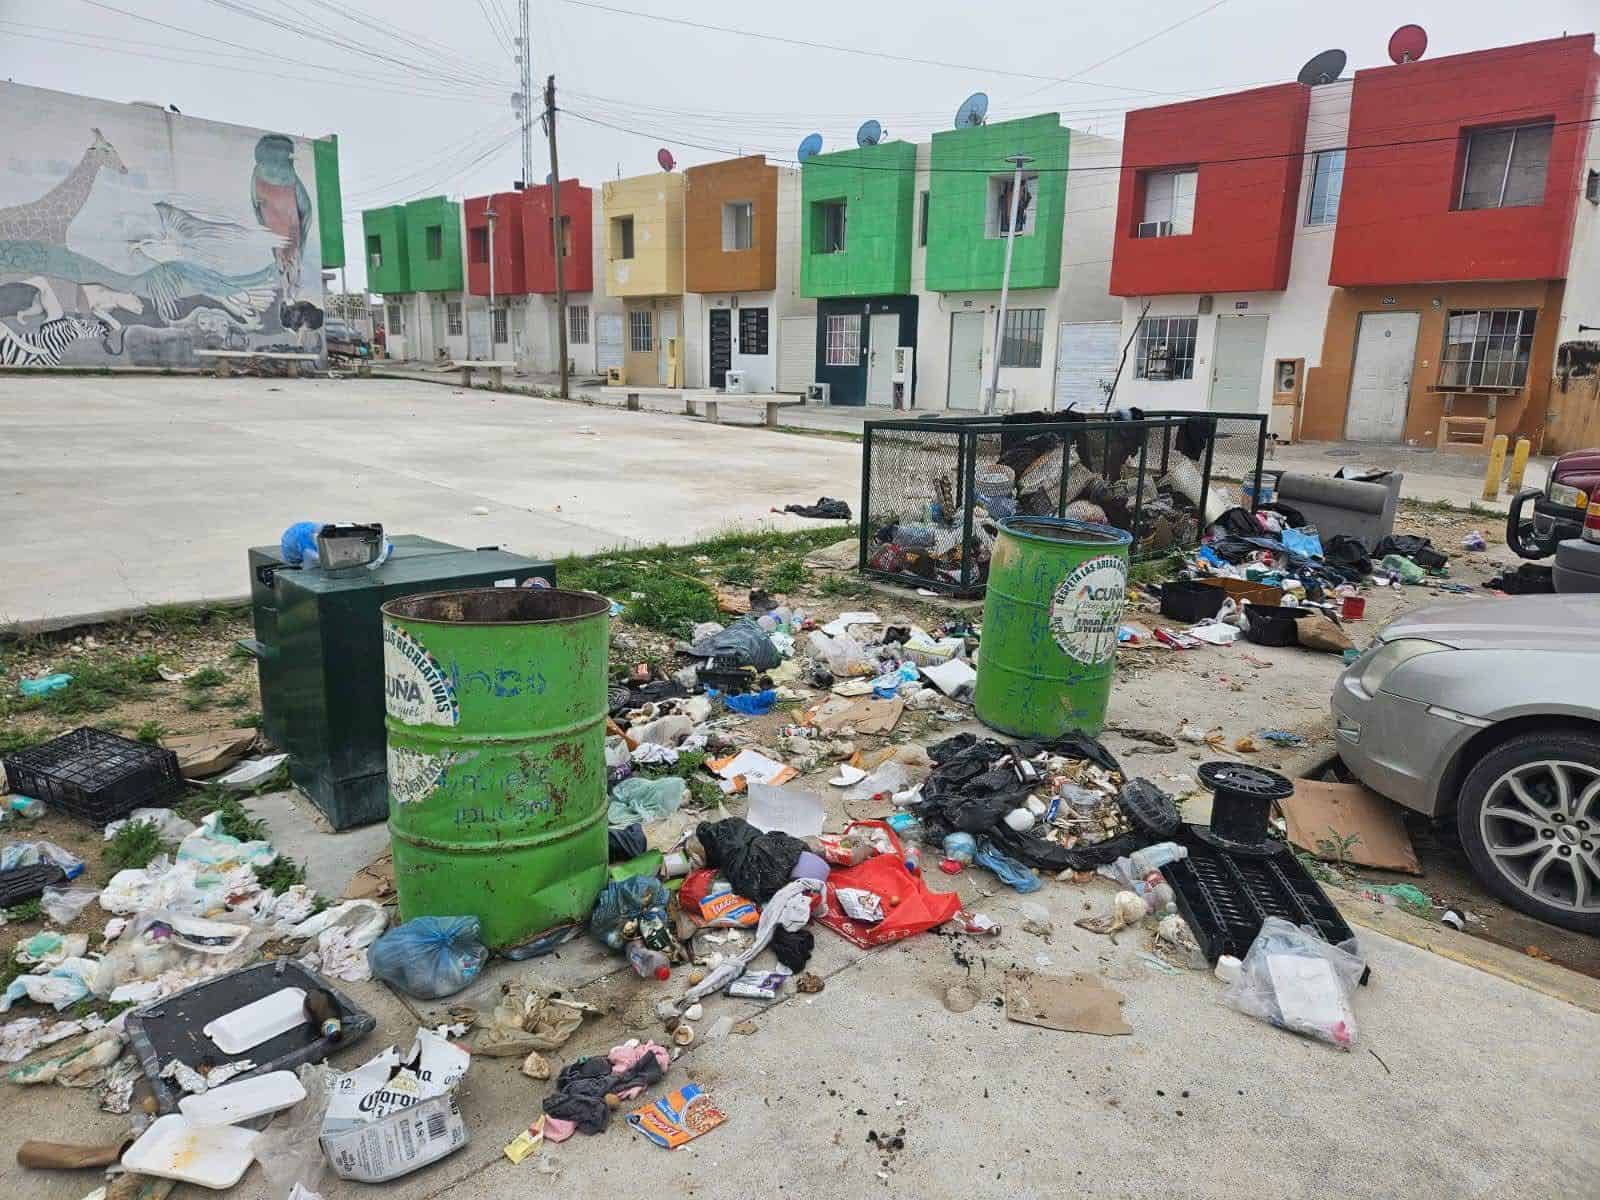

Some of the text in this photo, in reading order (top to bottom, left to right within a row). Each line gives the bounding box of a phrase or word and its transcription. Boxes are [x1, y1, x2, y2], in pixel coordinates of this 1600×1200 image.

[1056, 574, 1082, 605] RESPETA
[396, 635, 450, 713] RECREATIVAS
[340, 1077, 352, 1090] 12
